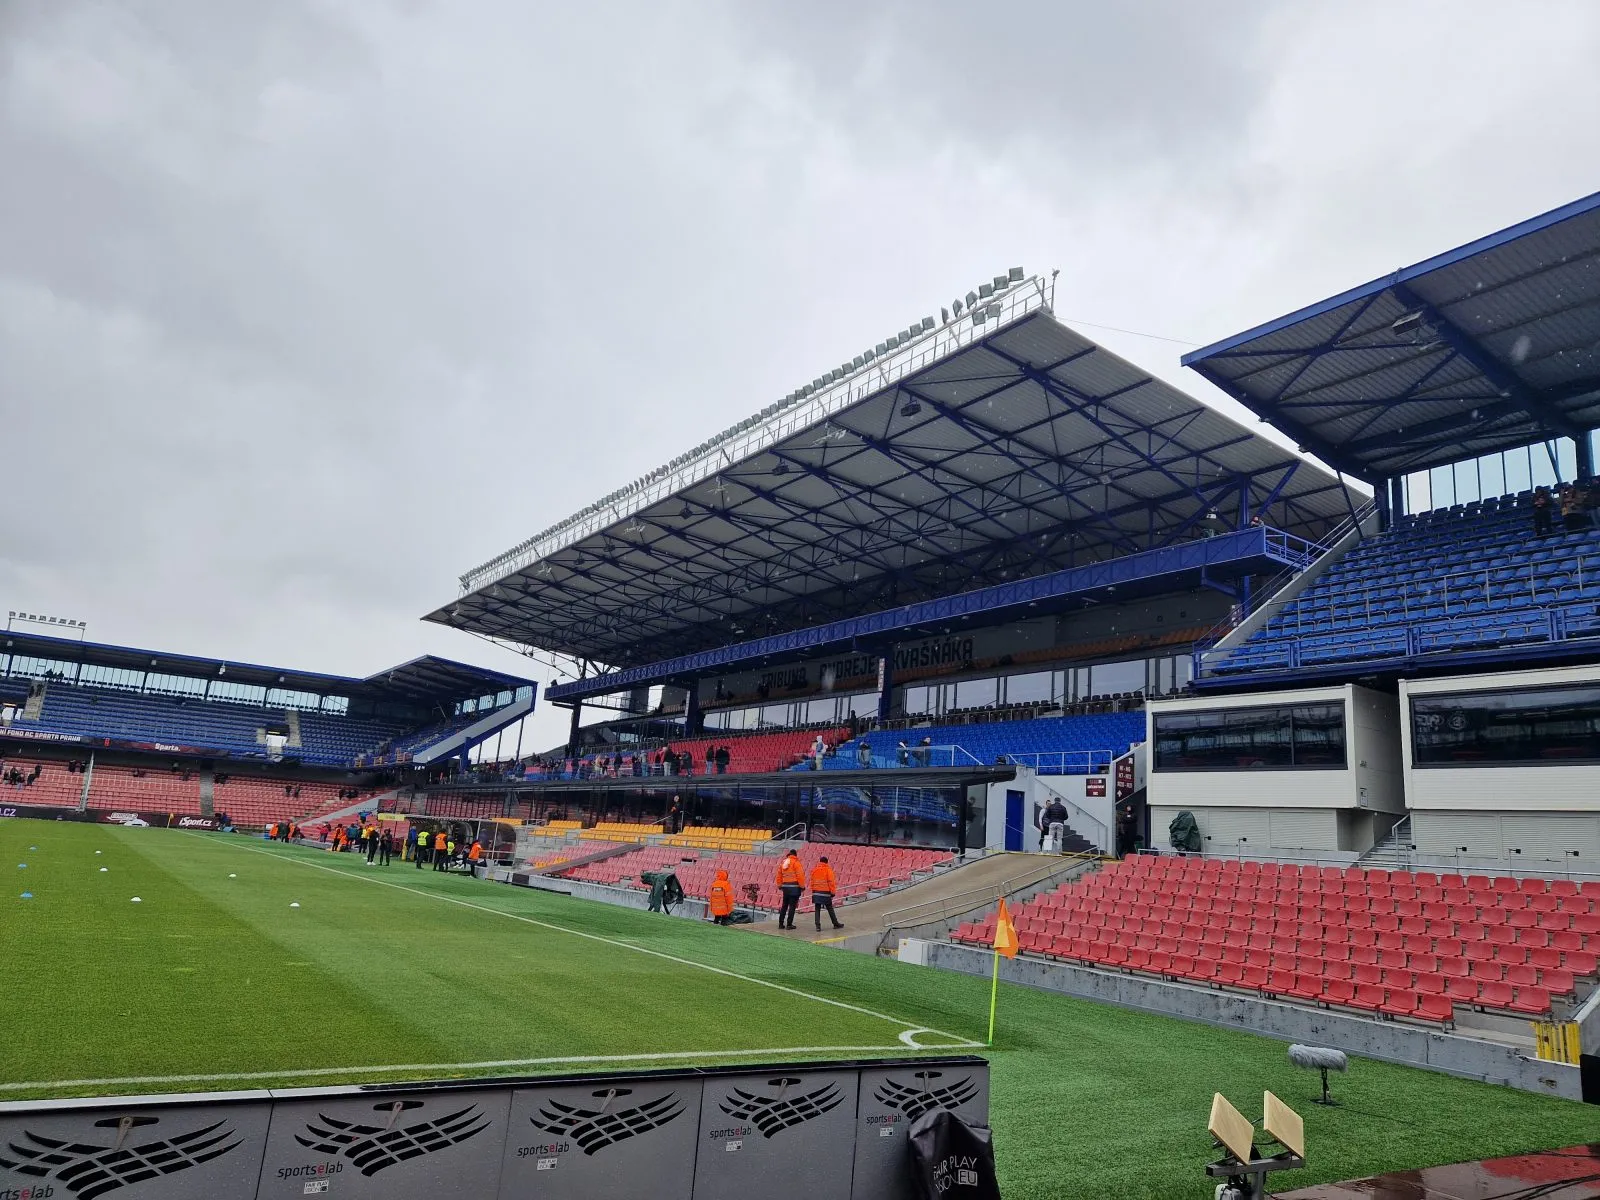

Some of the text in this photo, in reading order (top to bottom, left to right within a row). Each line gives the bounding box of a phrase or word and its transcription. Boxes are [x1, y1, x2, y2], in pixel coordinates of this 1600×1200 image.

[760, 667, 806, 688] TRIBUNA
[7, 729, 24, 737] FOND
[35, 732, 60, 741] SPARTA
[60, 734, 81, 742] PRAHA
[178, 816, 212, 827] iSport.cz
[866, 1113, 902, 1126] sportselab
[709, 1125, 752, 1140] sportselab
[517, 1141, 570, 1158] sportselab
[277, 1161, 343, 1180] sportselab
[933, 1155, 977, 1180] FAIR PLAY
[959, 1169, 978, 1186] EU
